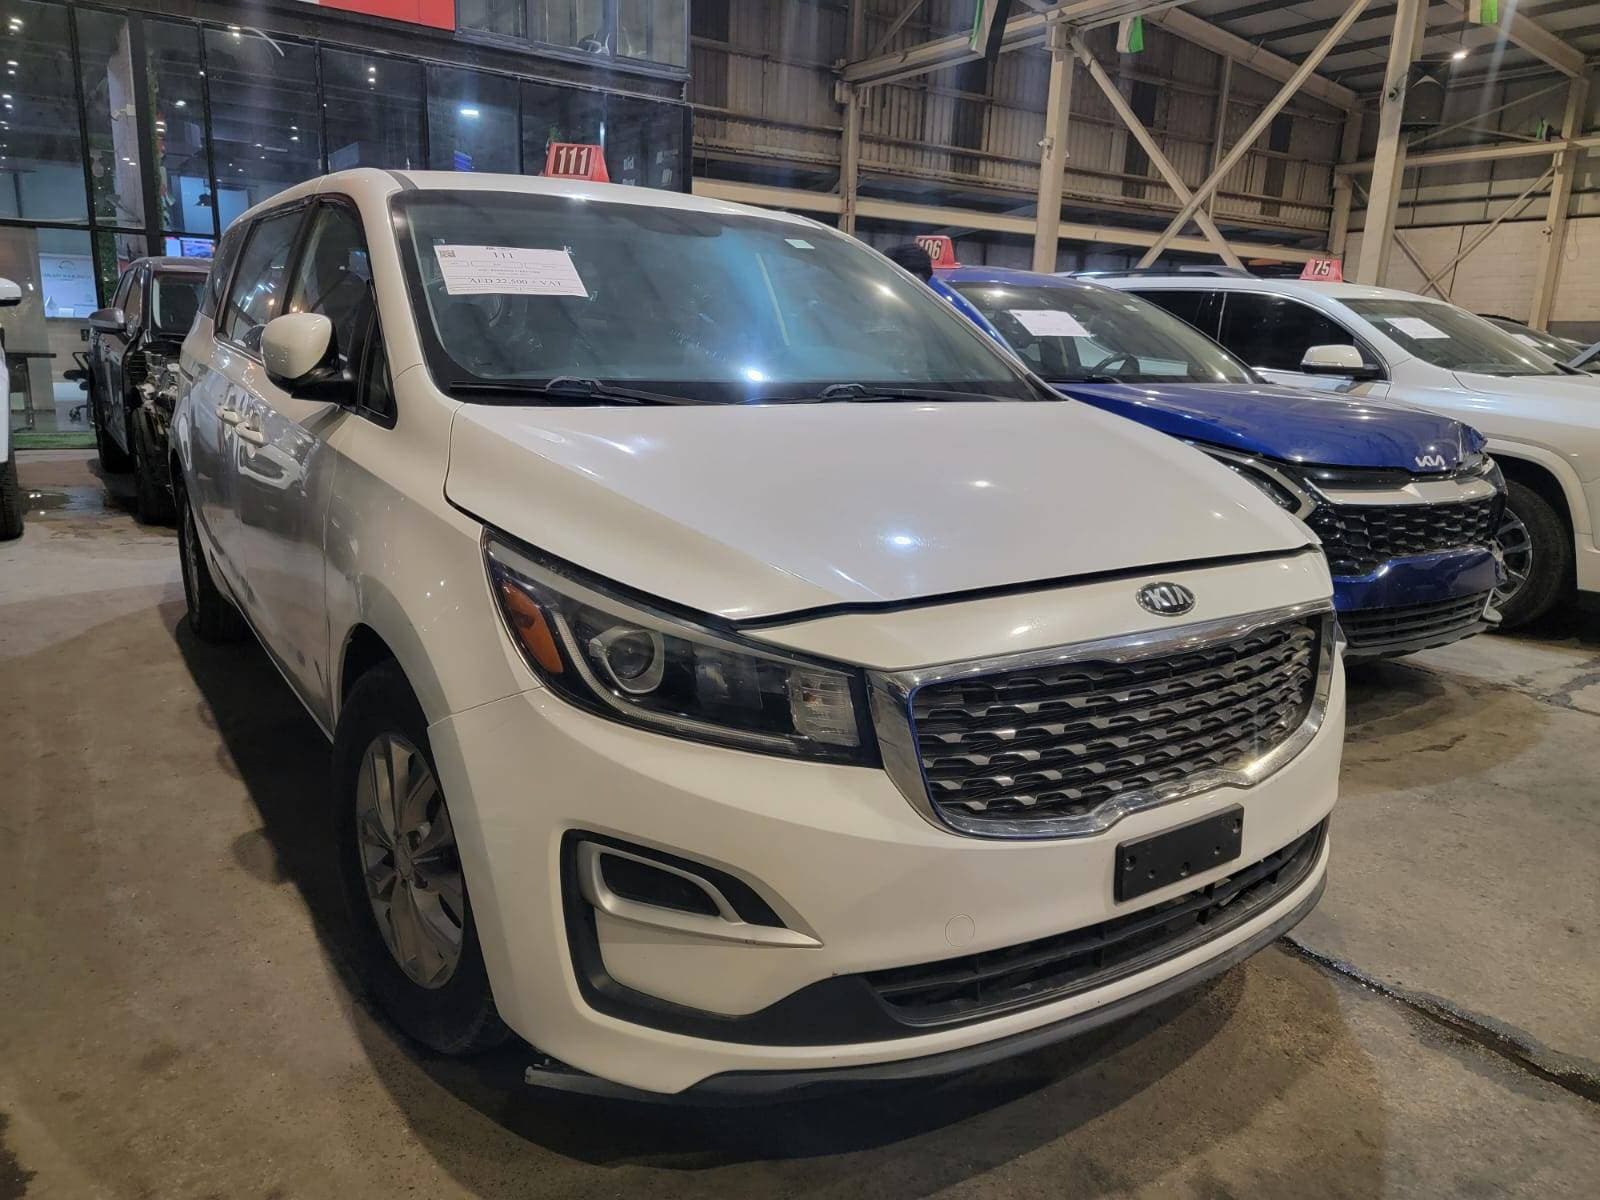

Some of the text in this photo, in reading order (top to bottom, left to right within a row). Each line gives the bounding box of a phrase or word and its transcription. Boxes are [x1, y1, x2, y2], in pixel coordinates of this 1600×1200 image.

[558, 146, 588, 175] 111
[1313, 260, 1331, 276] 75
[1144, 585, 1192, 610] KIA
